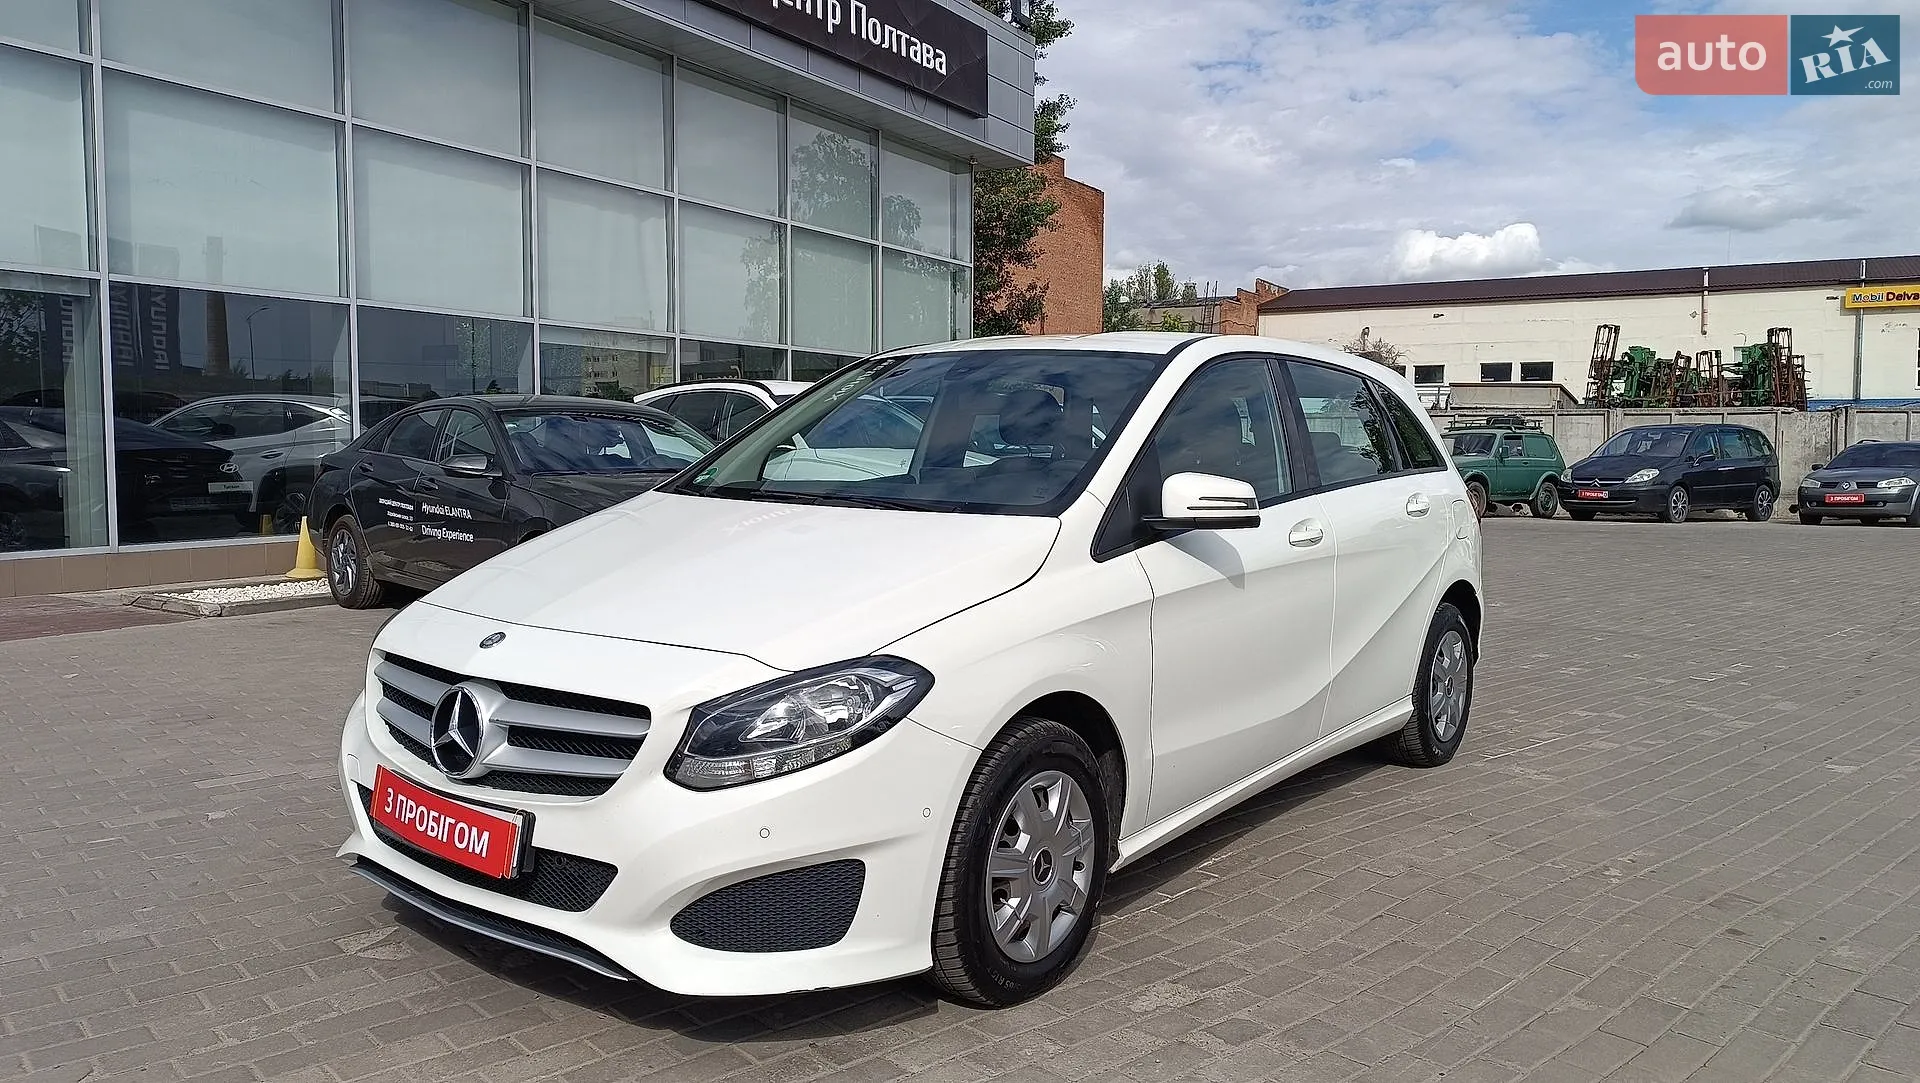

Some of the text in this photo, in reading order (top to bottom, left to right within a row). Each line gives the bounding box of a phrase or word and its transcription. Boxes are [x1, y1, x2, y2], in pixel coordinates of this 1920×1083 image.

[850, 1, 947, 76] Полтава
[1852, 293, 1884, 302] Mobil
[421, 502, 444, 515] Hyundai
[445, 506, 472, 519] ELANTRA
[421, 525, 442, 540] Driving
[442, 527, 474, 543] Experience
[384, 787, 490, 858] З ПРОБІГОМ
